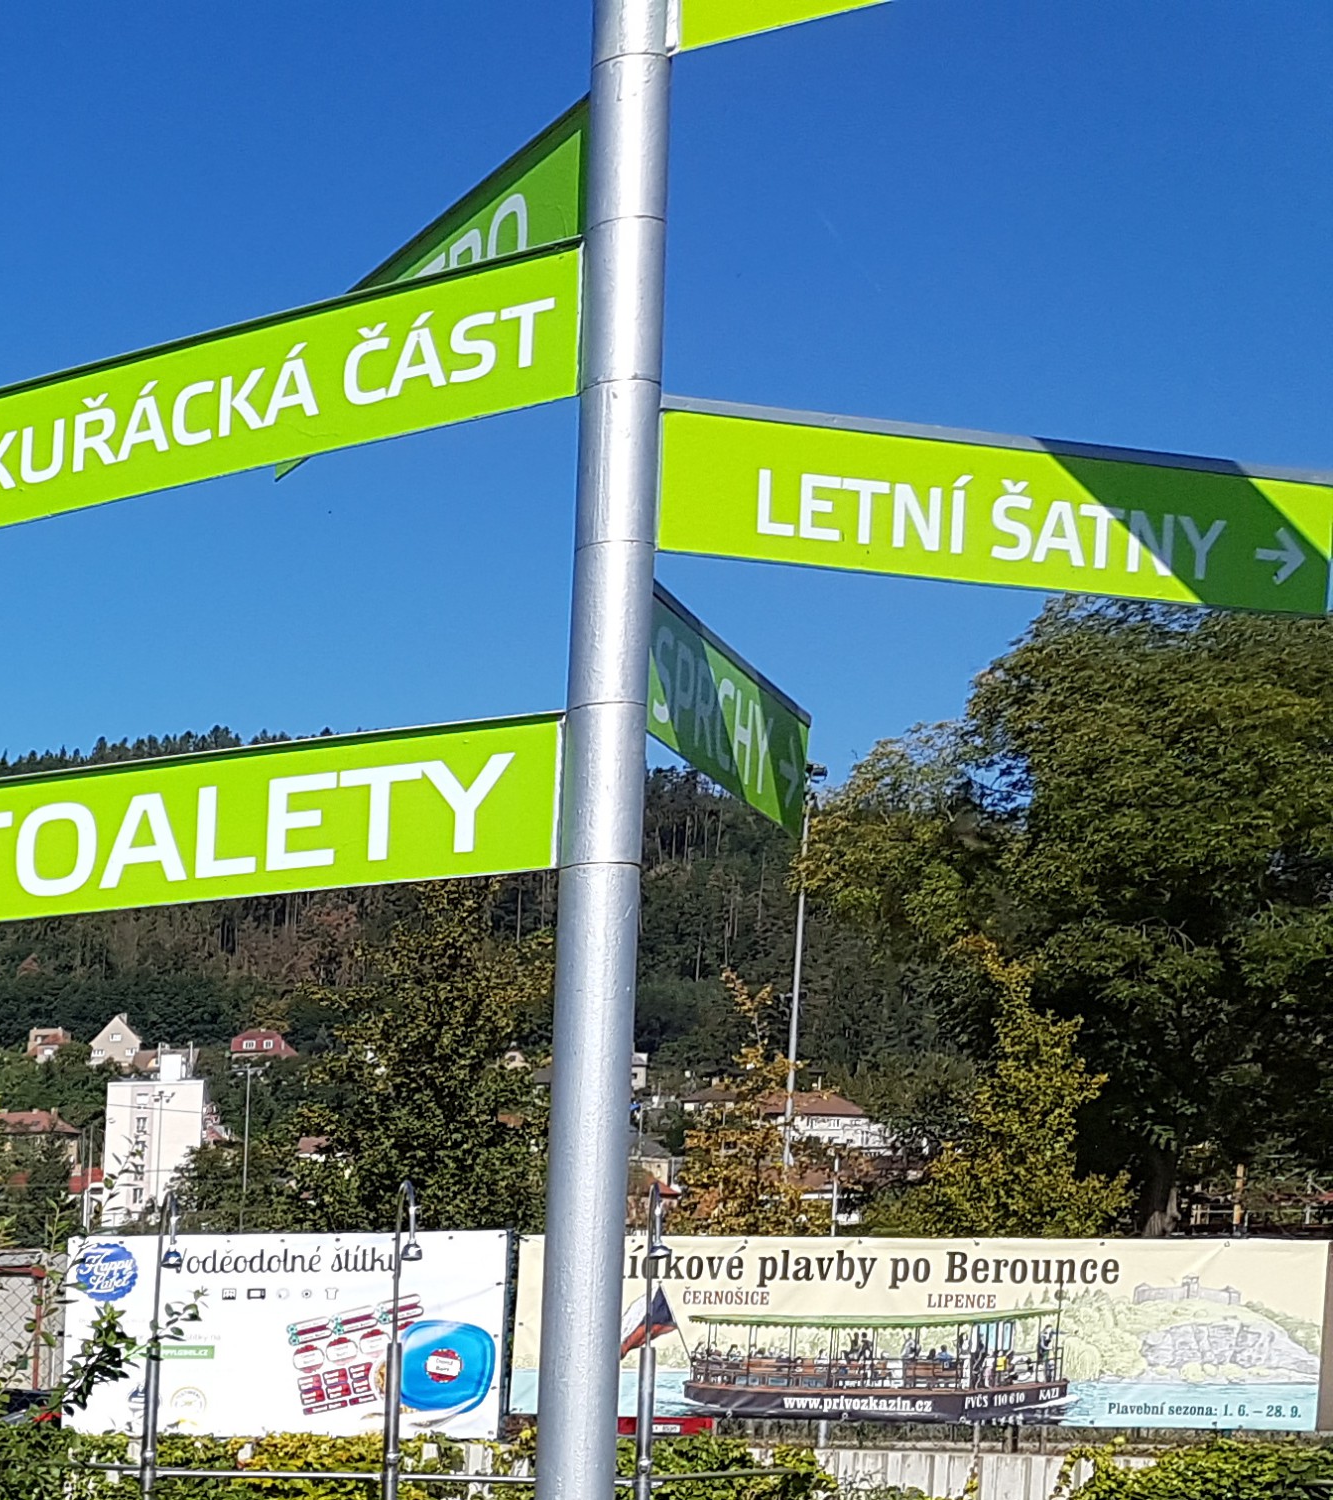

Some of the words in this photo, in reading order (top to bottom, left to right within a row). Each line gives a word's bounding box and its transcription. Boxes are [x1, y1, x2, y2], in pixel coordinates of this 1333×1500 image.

[341, 297, 556, 406] ČÁST
[756, 469, 974, 555] LETNÍ
[991, 479, 1228, 581] ŠATNY
[653, 626, 774, 795] SPRCHY
[79, 1248, 134, 1275] Happy
[623, 1244, 747, 1280] ídkové
[756, 1249, 879, 1288] plavby
[889, 1256, 931, 1289] po
[944, 1250, 1121, 1285] Berounce
[86, 1274, 131, 1294] Label
[683, 1286, 770, 1306] ČERNOŠICE
[926, 1293, 997, 1309] LIPENCE
[1107, 1401, 1166, 1416] Plavební
[1167, 1405, 1218, 1417] sezona:
[1265, 1404, 1286, 1418] 28.
[1289, 1405, 1302, 1418] 9.
